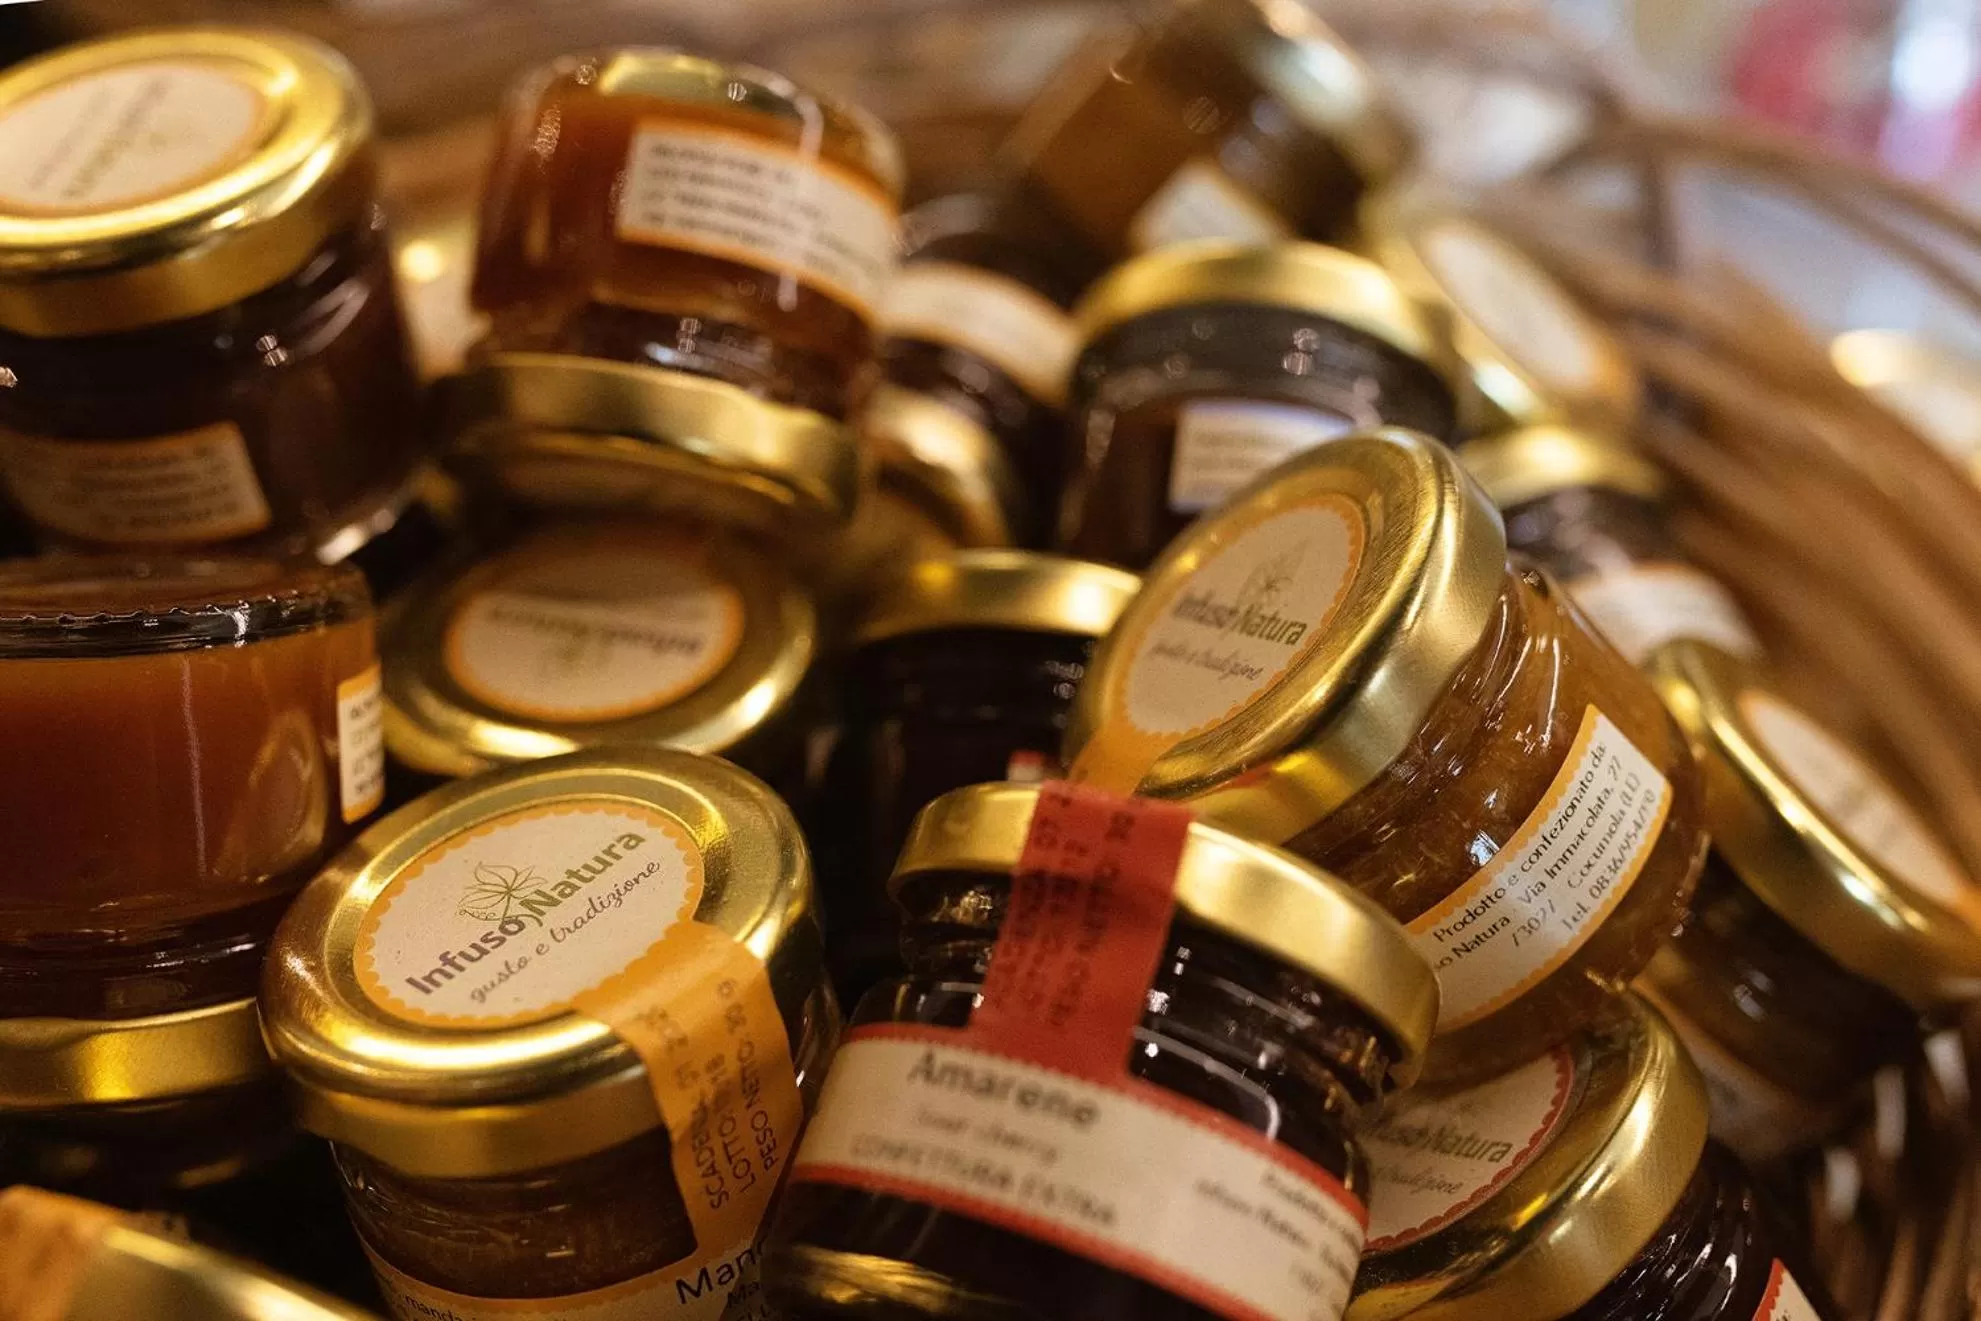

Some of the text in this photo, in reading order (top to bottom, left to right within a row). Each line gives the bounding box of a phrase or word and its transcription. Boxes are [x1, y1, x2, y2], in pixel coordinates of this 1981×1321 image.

[1433, 884, 1507, 943] Prodotto
[1508, 872, 1520, 888] e
[1520, 775, 1595, 874] confezionato
[1451, 914, 1511, 961] Natura
[1520, 879, 1547, 905] Via
[1543, 787, 1615, 880] Immacolata,
[1566, 808, 1625, 889] Cocumola
[405, 829, 647, 996] Infuso Natura
[471, 859, 661, 1005] gusto e tradizione
[751, 1109, 780, 1172] PESO
[907, 1048, 1099, 1131] Amarene
[1430, 1124, 1514, 1163] Natura
